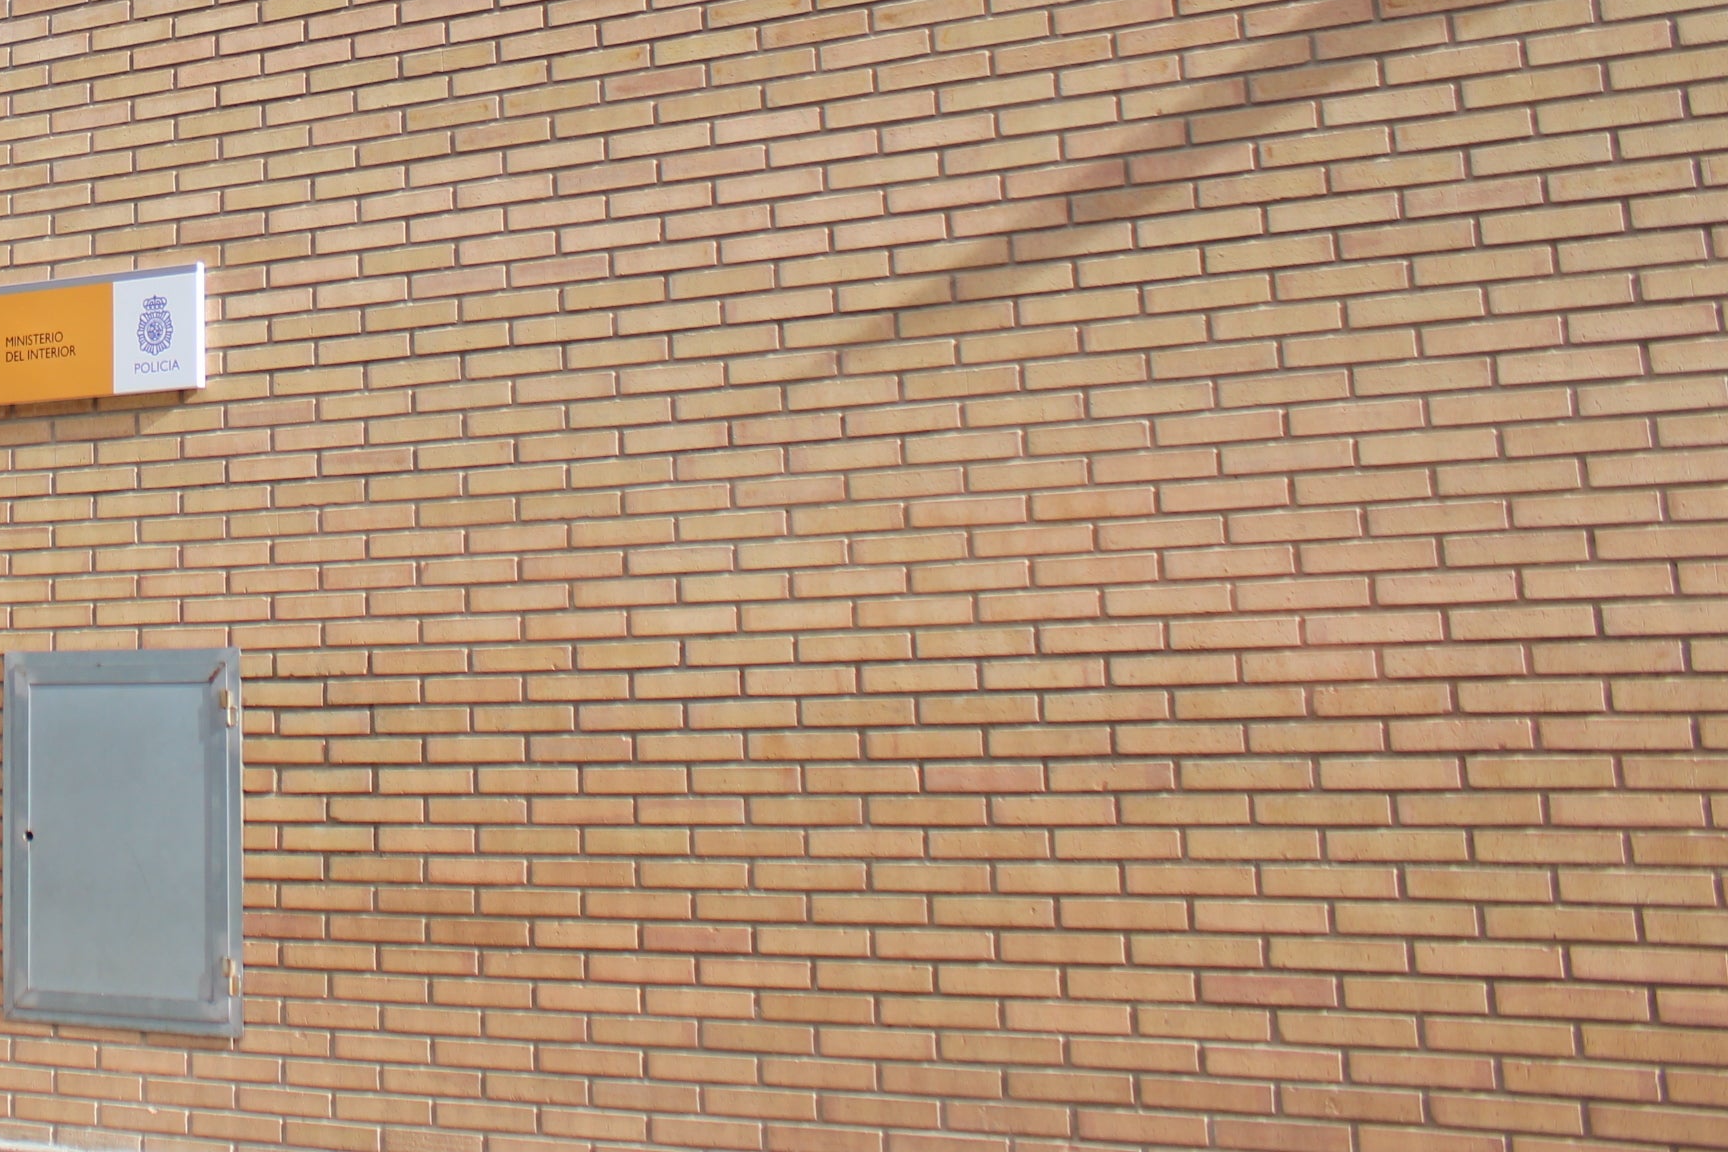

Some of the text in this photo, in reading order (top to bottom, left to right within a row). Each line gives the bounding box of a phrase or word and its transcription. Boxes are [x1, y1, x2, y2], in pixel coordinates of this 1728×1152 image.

[5, 331, 64, 348] MINISTERIO
[5, 345, 77, 363] DEL INTERIOR
[133, 359, 181, 375] POLICIA
